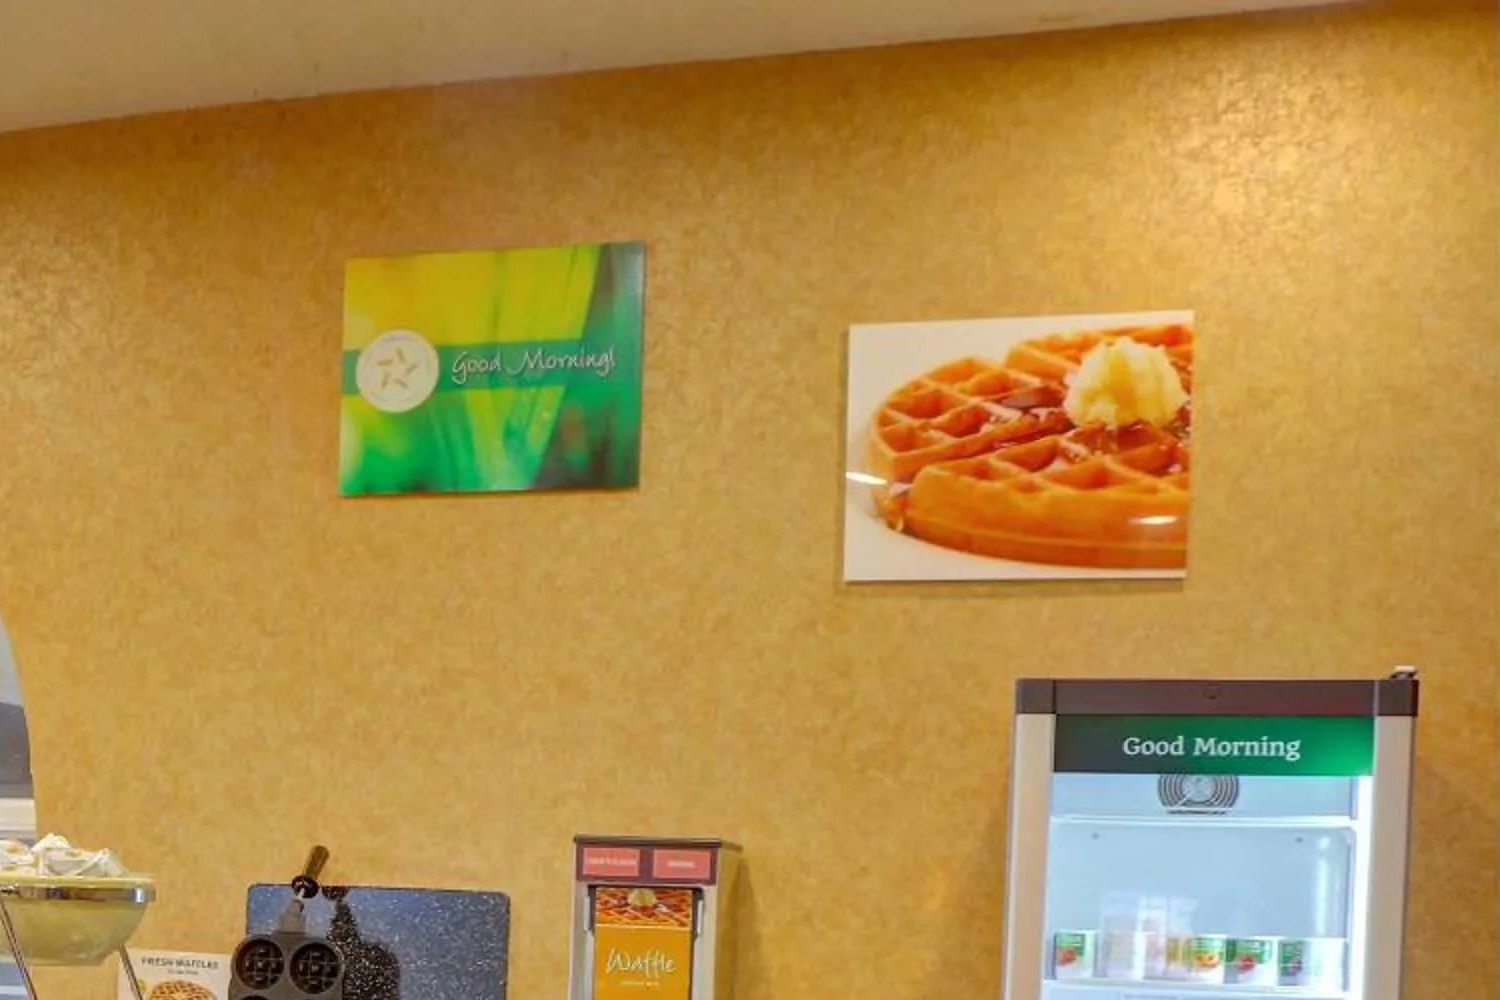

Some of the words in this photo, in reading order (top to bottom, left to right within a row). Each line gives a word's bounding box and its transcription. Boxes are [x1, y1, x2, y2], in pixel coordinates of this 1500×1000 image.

[450, 350, 503, 385] Good
[506, 346, 617, 378] Morning!
[1122, 735, 1185, 756] Good
[1192, 736, 1301, 762] Morning
[605, 947, 677, 979] Waffle
